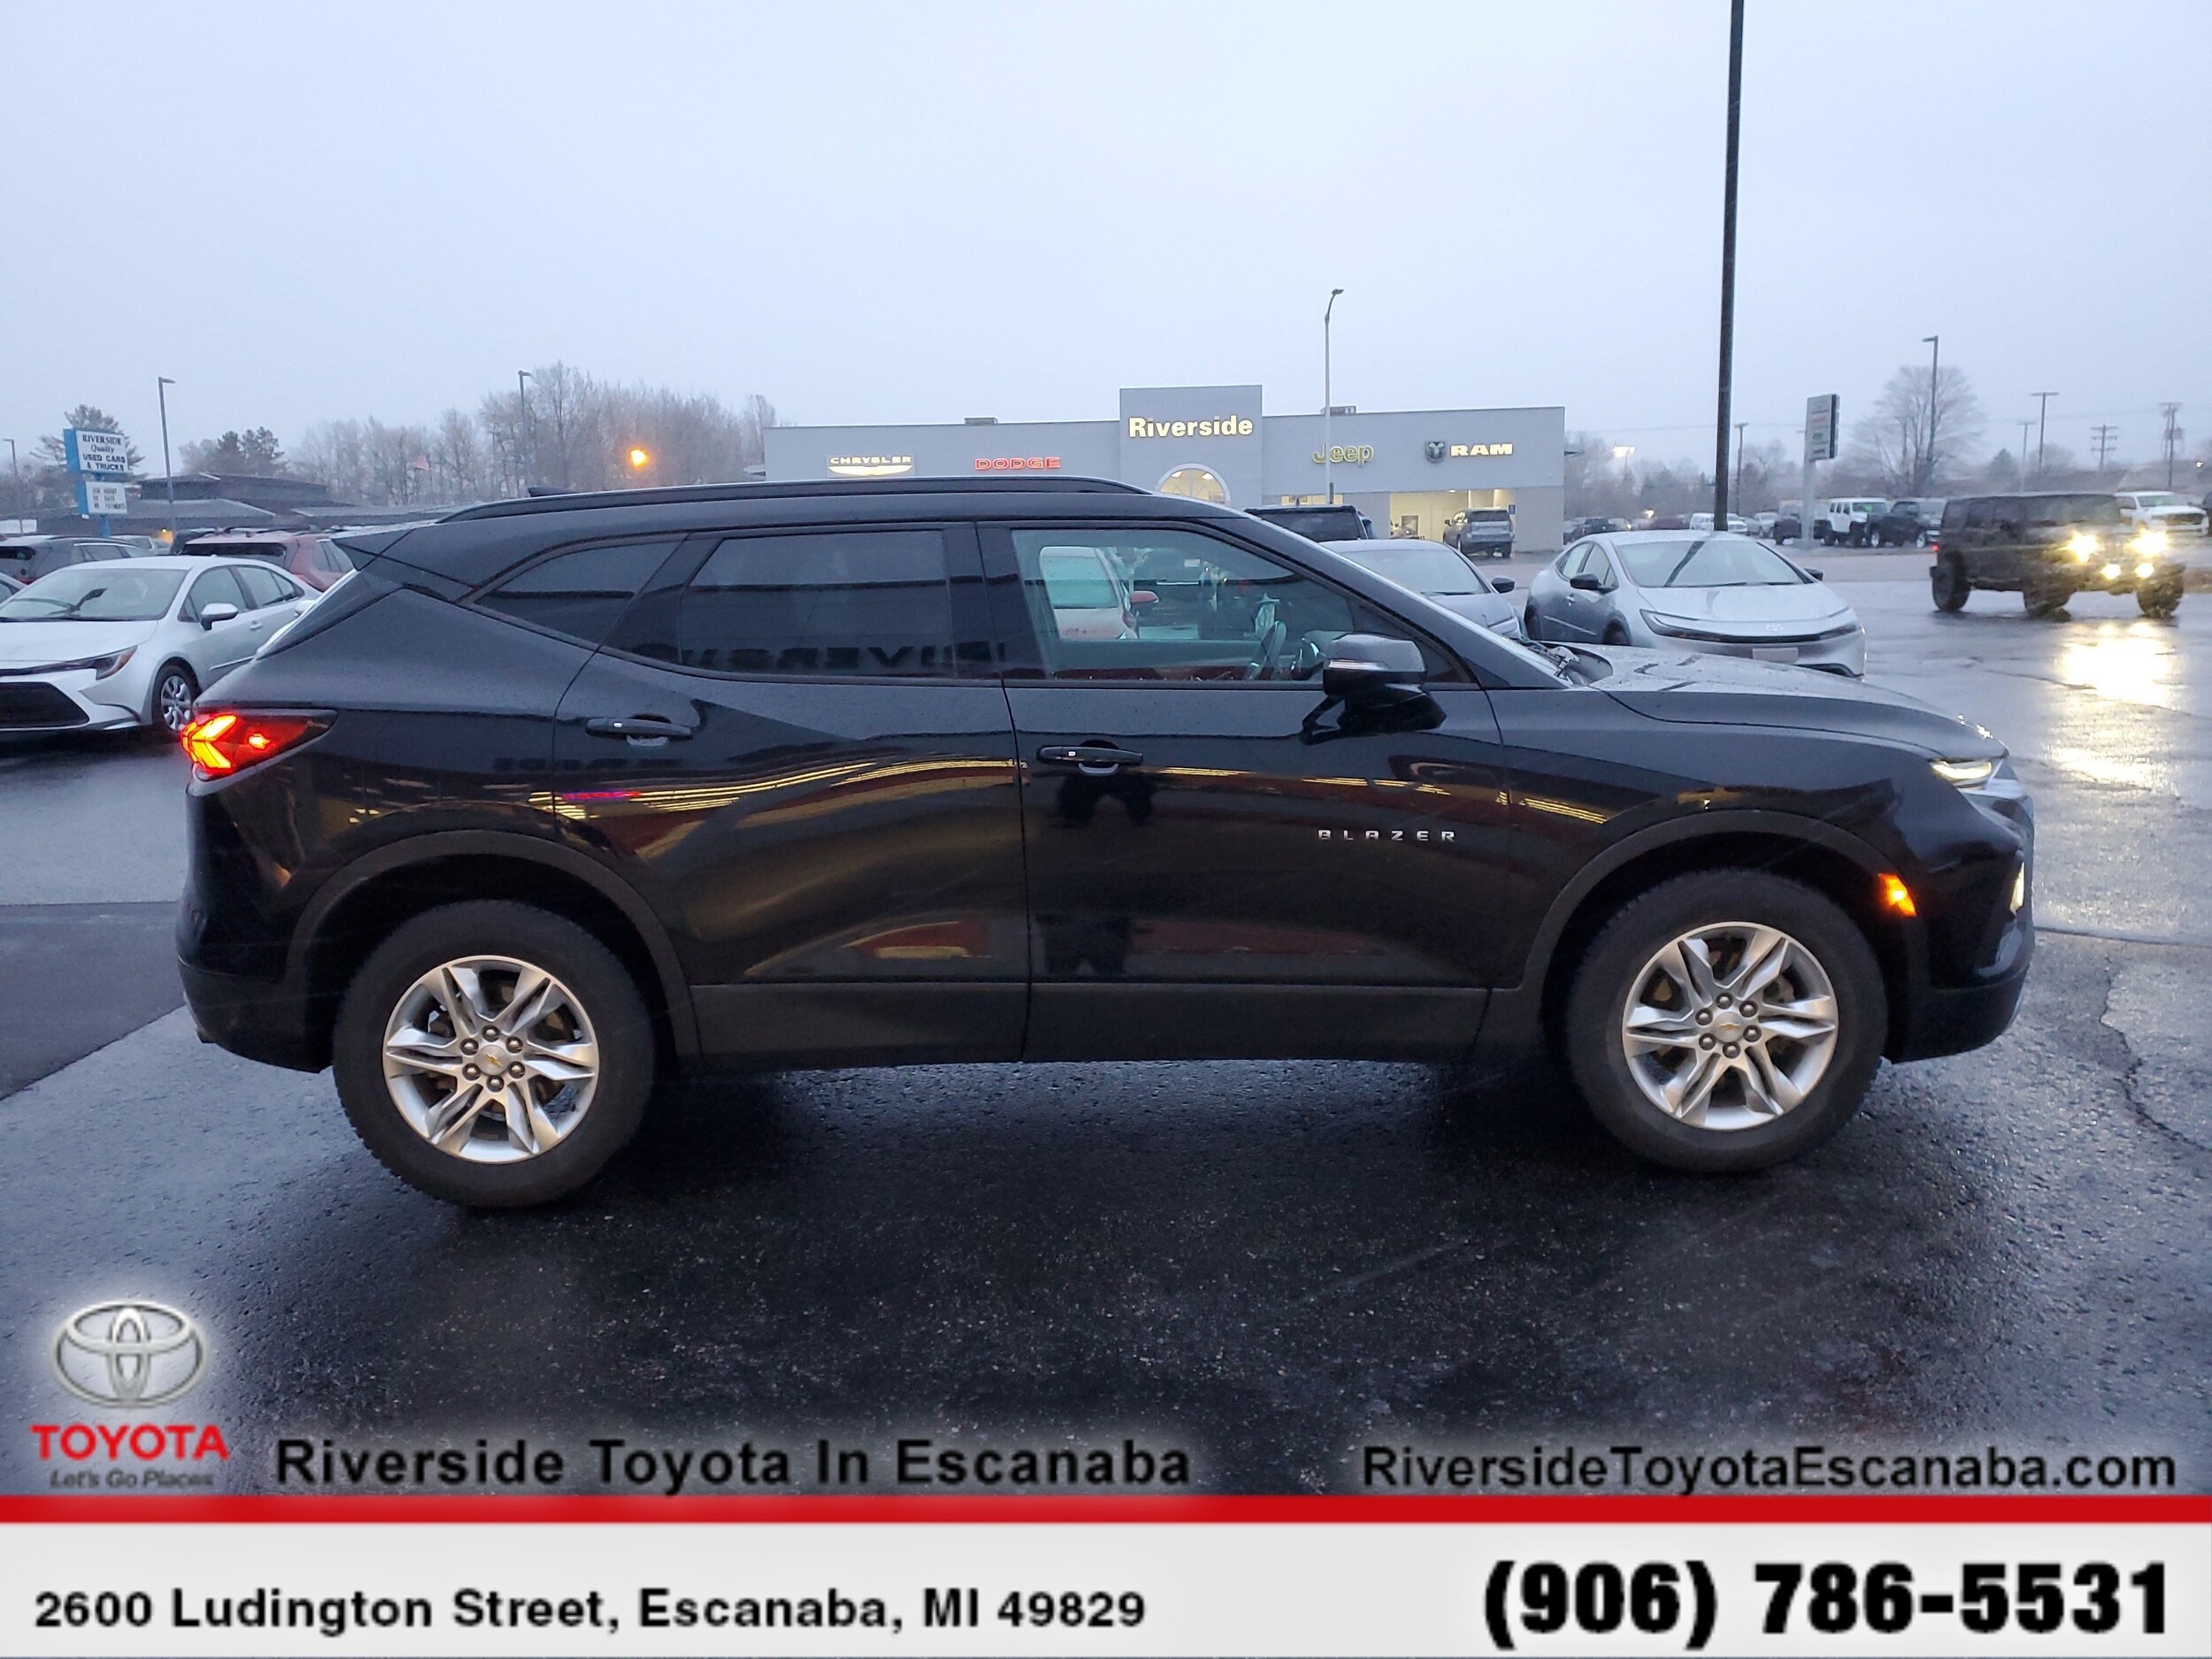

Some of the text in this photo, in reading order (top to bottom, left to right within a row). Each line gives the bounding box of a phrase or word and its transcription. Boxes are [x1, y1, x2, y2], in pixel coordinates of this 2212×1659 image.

[1128, 414, 1254, 438] Riverside
[82, 434, 122, 445] RIVERSIDE
[1312, 443, 1374, 467] Jeep
[1450, 442, 1513, 457] RAM
[105, 455, 126, 464] CARS
[829, 456, 912, 465] CHRYSLER
[974, 457, 1060, 470] DODGE
[1317, 829, 1455, 841] BLAZER
